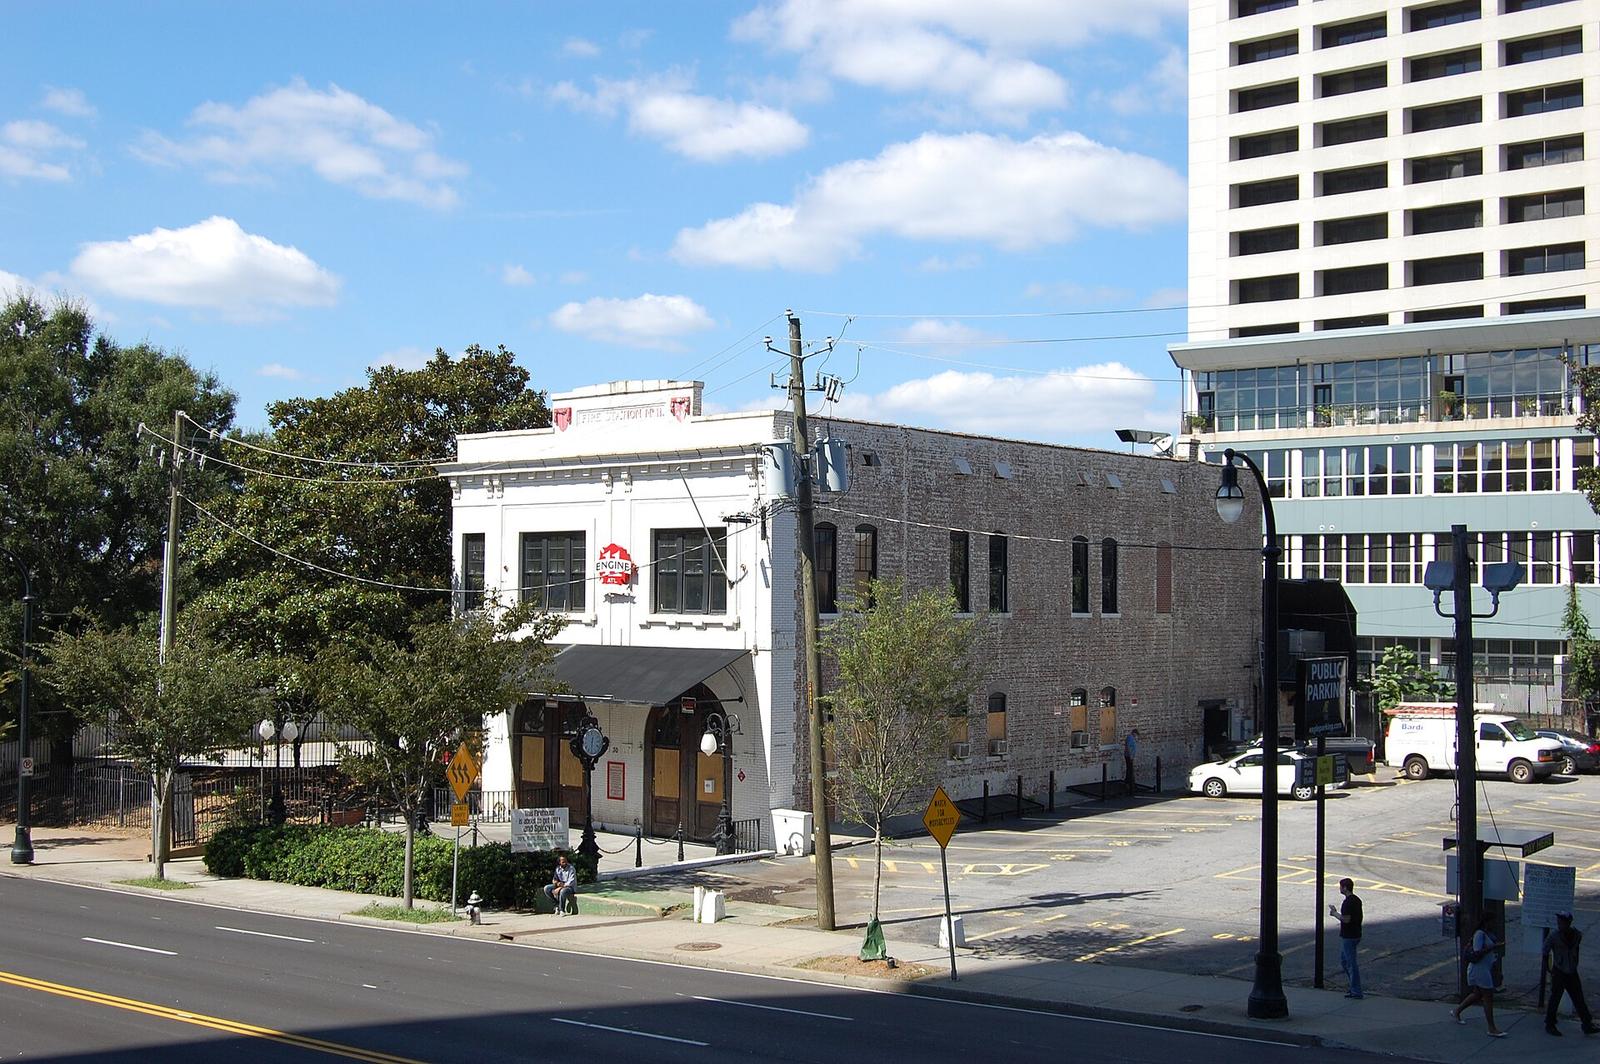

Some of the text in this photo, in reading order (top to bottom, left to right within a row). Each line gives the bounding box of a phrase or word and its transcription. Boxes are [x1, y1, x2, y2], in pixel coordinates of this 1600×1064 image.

[606, 409, 642, 422] STATION
[596, 561, 630, 571] ENGINE
[1311, 662, 1342, 680] PUBLIC
